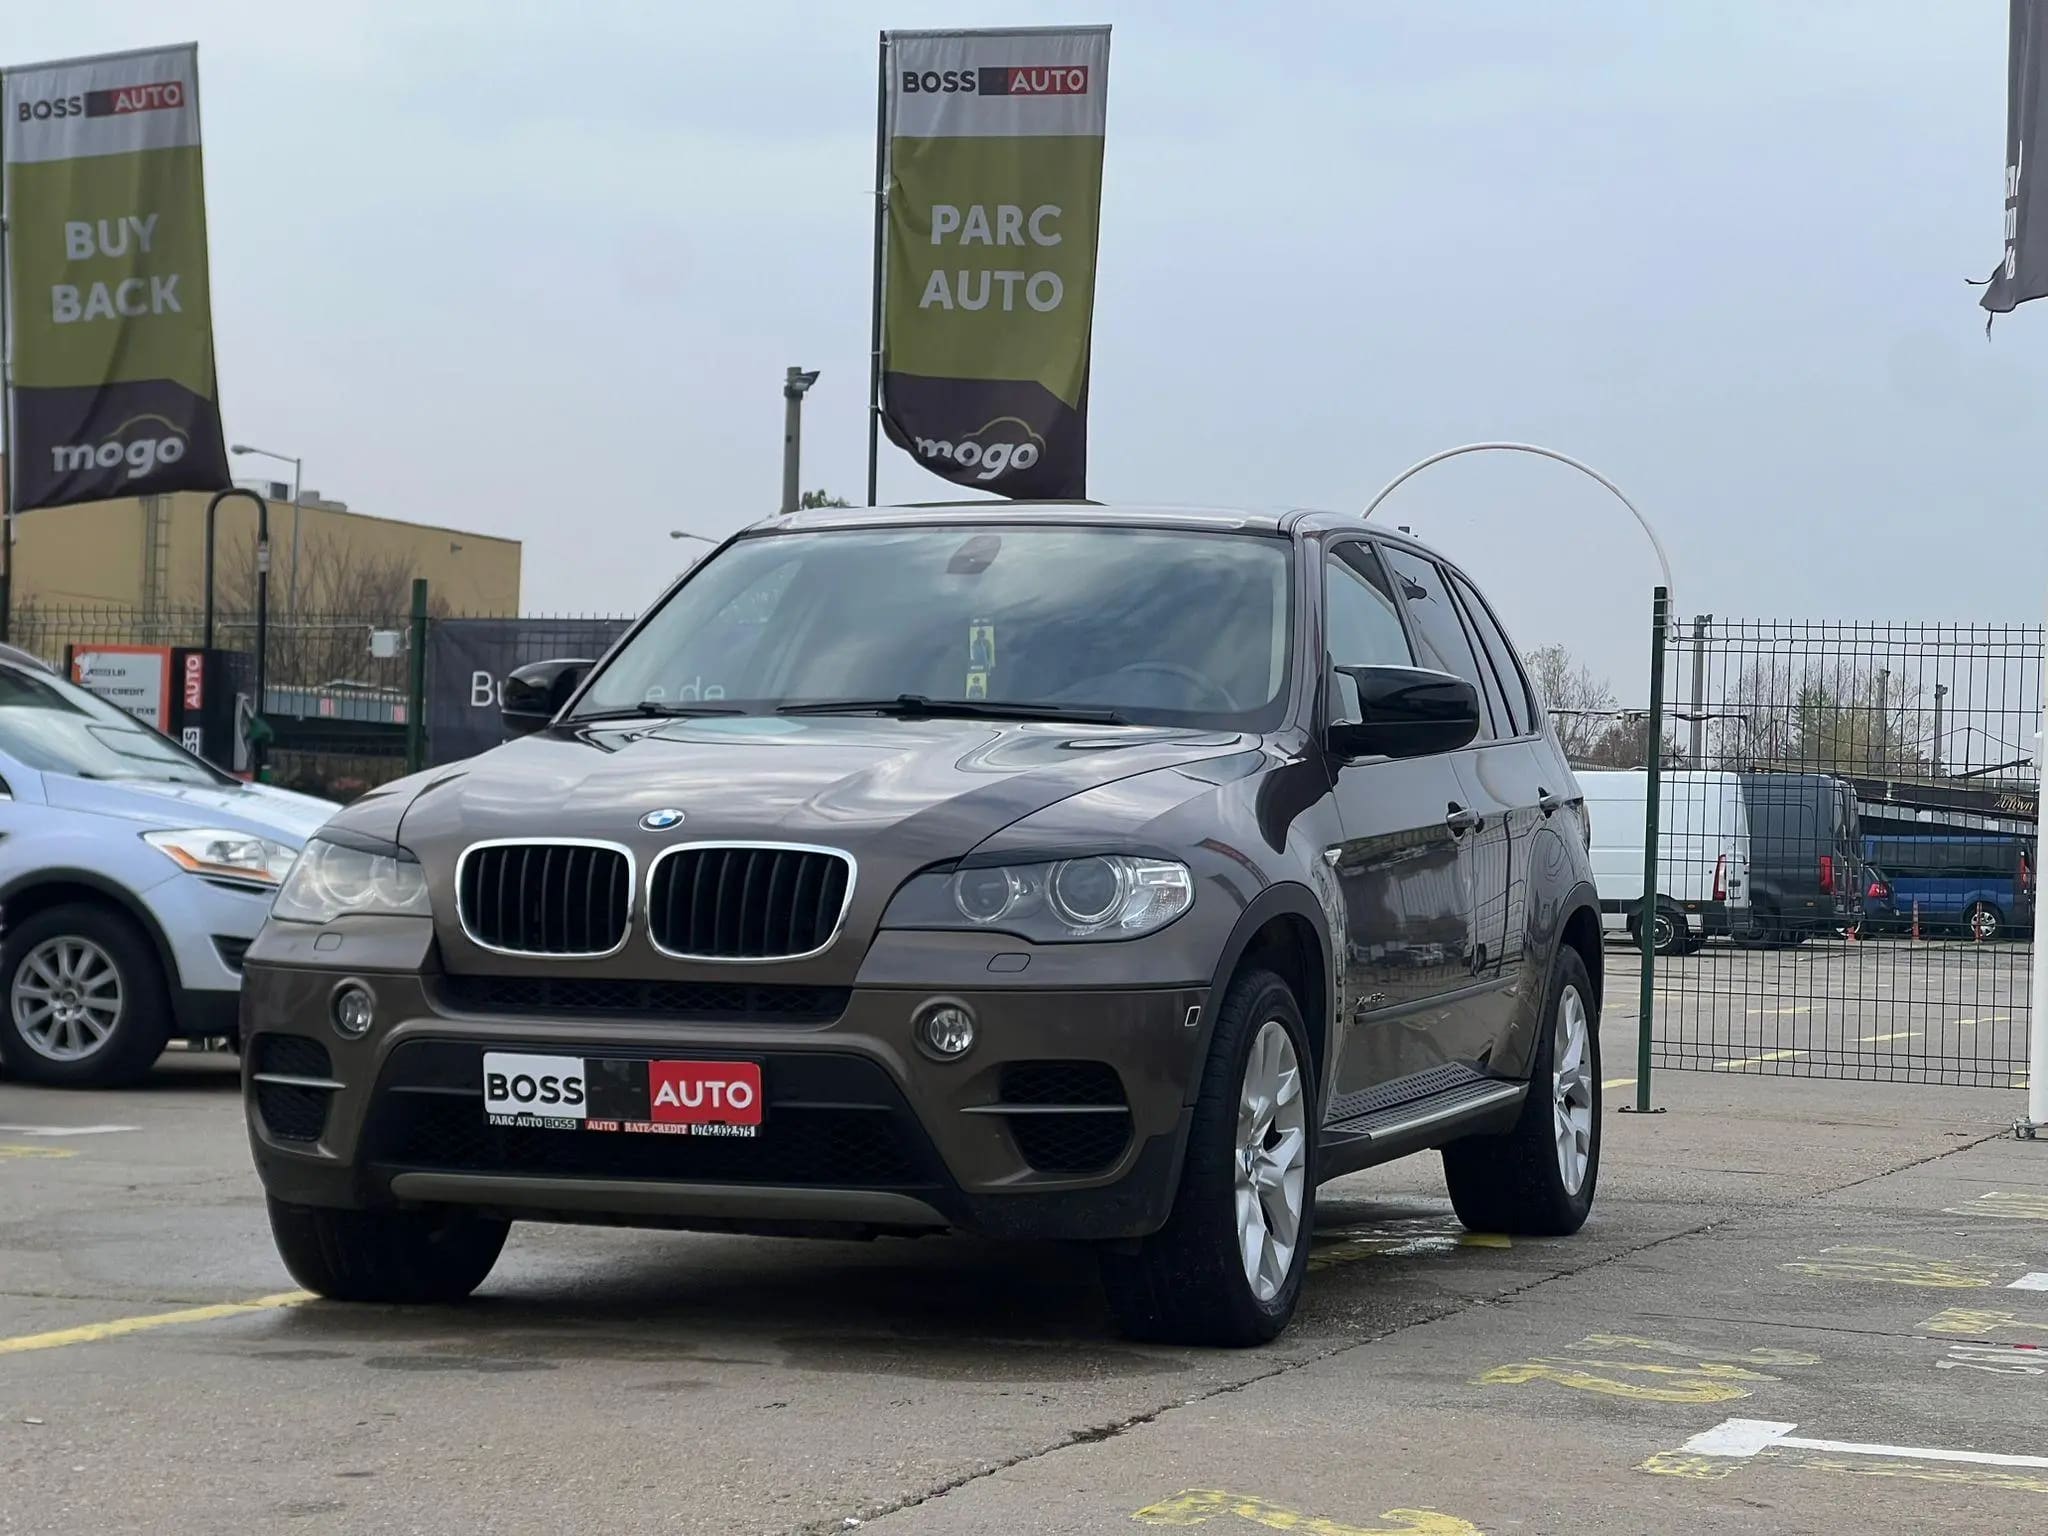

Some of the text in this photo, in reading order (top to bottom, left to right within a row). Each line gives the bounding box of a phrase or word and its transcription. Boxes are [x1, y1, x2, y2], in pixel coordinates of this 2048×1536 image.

[902, 69, 1085, 93] BOSS AUTO
[18, 83, 181, 122] BOSS AUTO
[65, 213, 159, 260] BUY
[930, 204, 1062, 246] PARC
[52, 273, 182, 323] BACK
[918, 269, 1064, 312] AUTO
[51, 436, 185, 478] mogo
[915, 436, 1038, 480] mogo
[186, 656, 200, 708] AUTO
[487, 1073, 754, 1109] BOSS AUTO
[489, 1115, 514, 1126] PARC
[516, 1117, 543, 1127] AUTO
[545, 1118, 576, 1129] BOSS
[587, 1121, 618, 1131] AUTO
